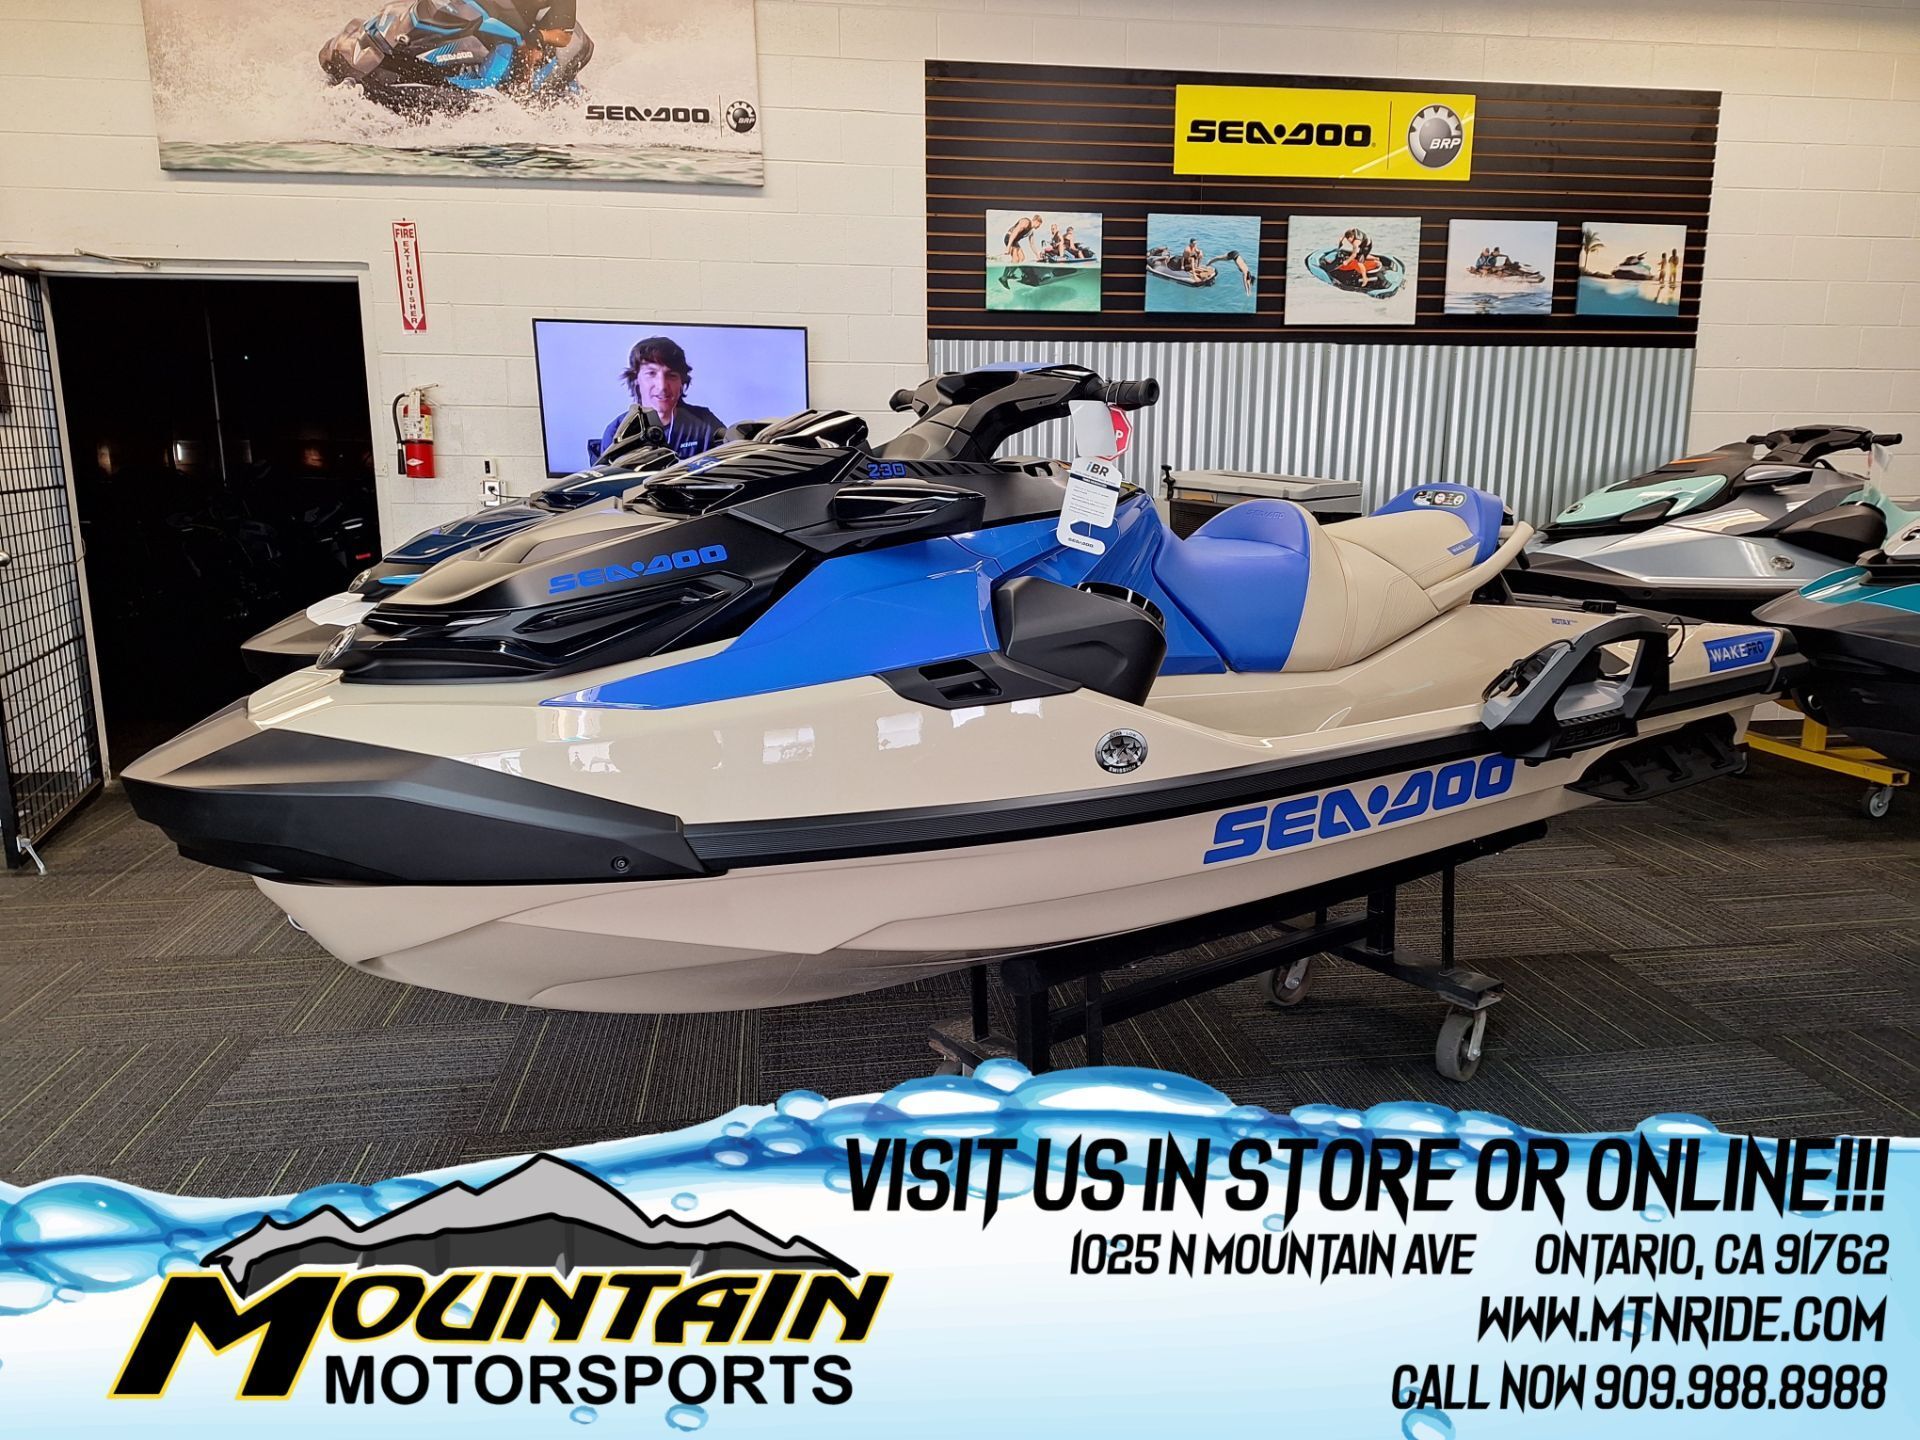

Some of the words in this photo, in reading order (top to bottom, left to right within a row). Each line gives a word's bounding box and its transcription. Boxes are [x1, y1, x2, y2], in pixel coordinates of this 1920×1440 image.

[738, 117, 756, 125] BRP
[1429, 137, 1462, 150] BRP
[395, 228, 415, 239] FIRE
[402, 240, 418, 324] EXTINGUISHER
[867, 463, 906, 478] 230
[1086, 461, 1109, 477] iBR
